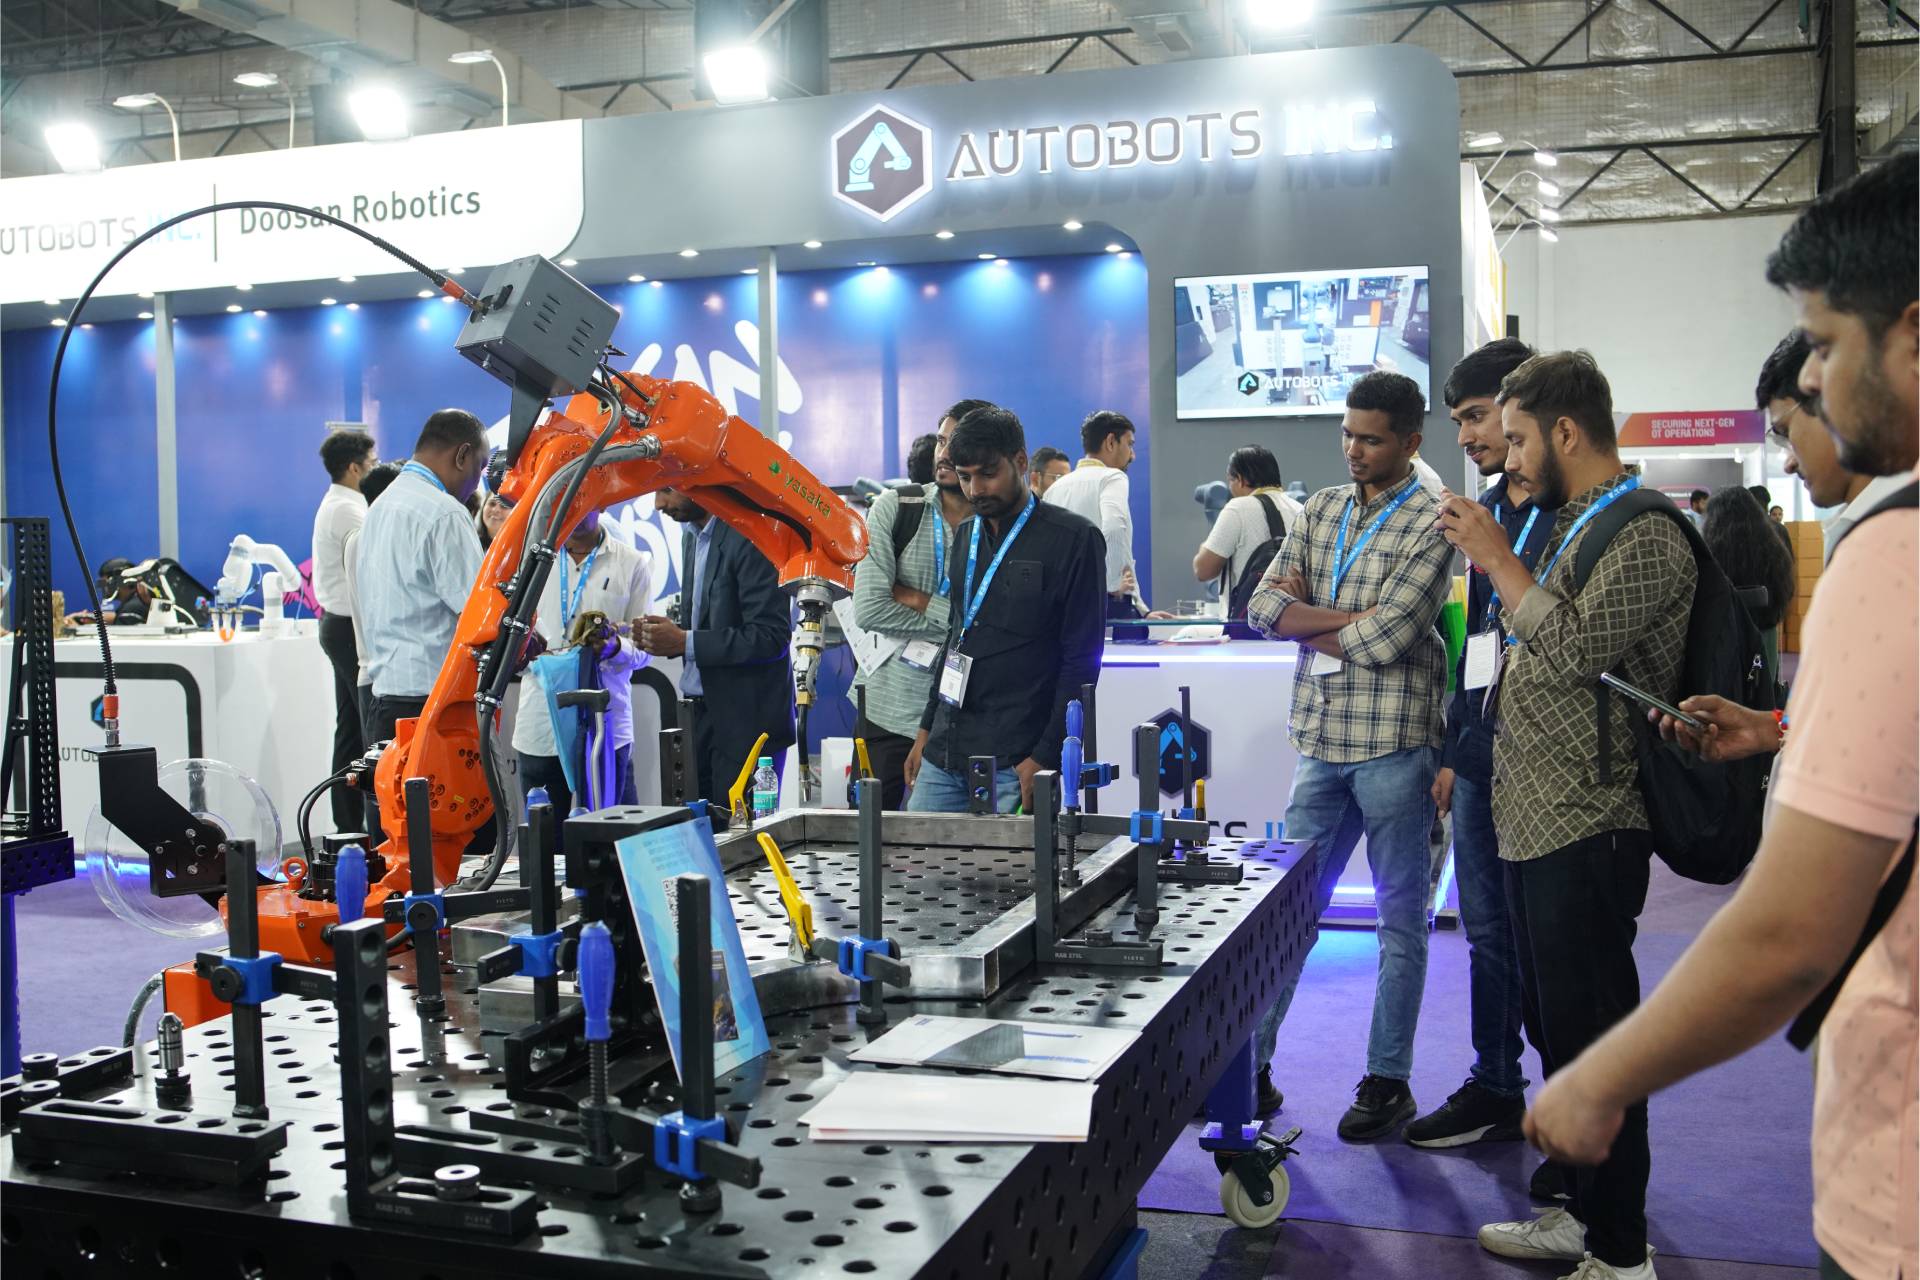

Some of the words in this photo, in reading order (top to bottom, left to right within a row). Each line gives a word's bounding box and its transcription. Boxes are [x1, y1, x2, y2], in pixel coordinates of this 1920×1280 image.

[945, 110, 1263, 181] AUTOBOTS
[1284, 101, 1393, 157] INC.
[240, 203, 342, 234] Doosan
[353, 186, 481, 224] Robotics
[1651, 419, 1692, 429] SECURING
[1694, 417, 1735, 428] NEXT-GEN
[1651, 428, 1661, 438] OT
[1664, 428, 1715, 438] OPERATIONS
[785, 472, 831, 518] yasaka
